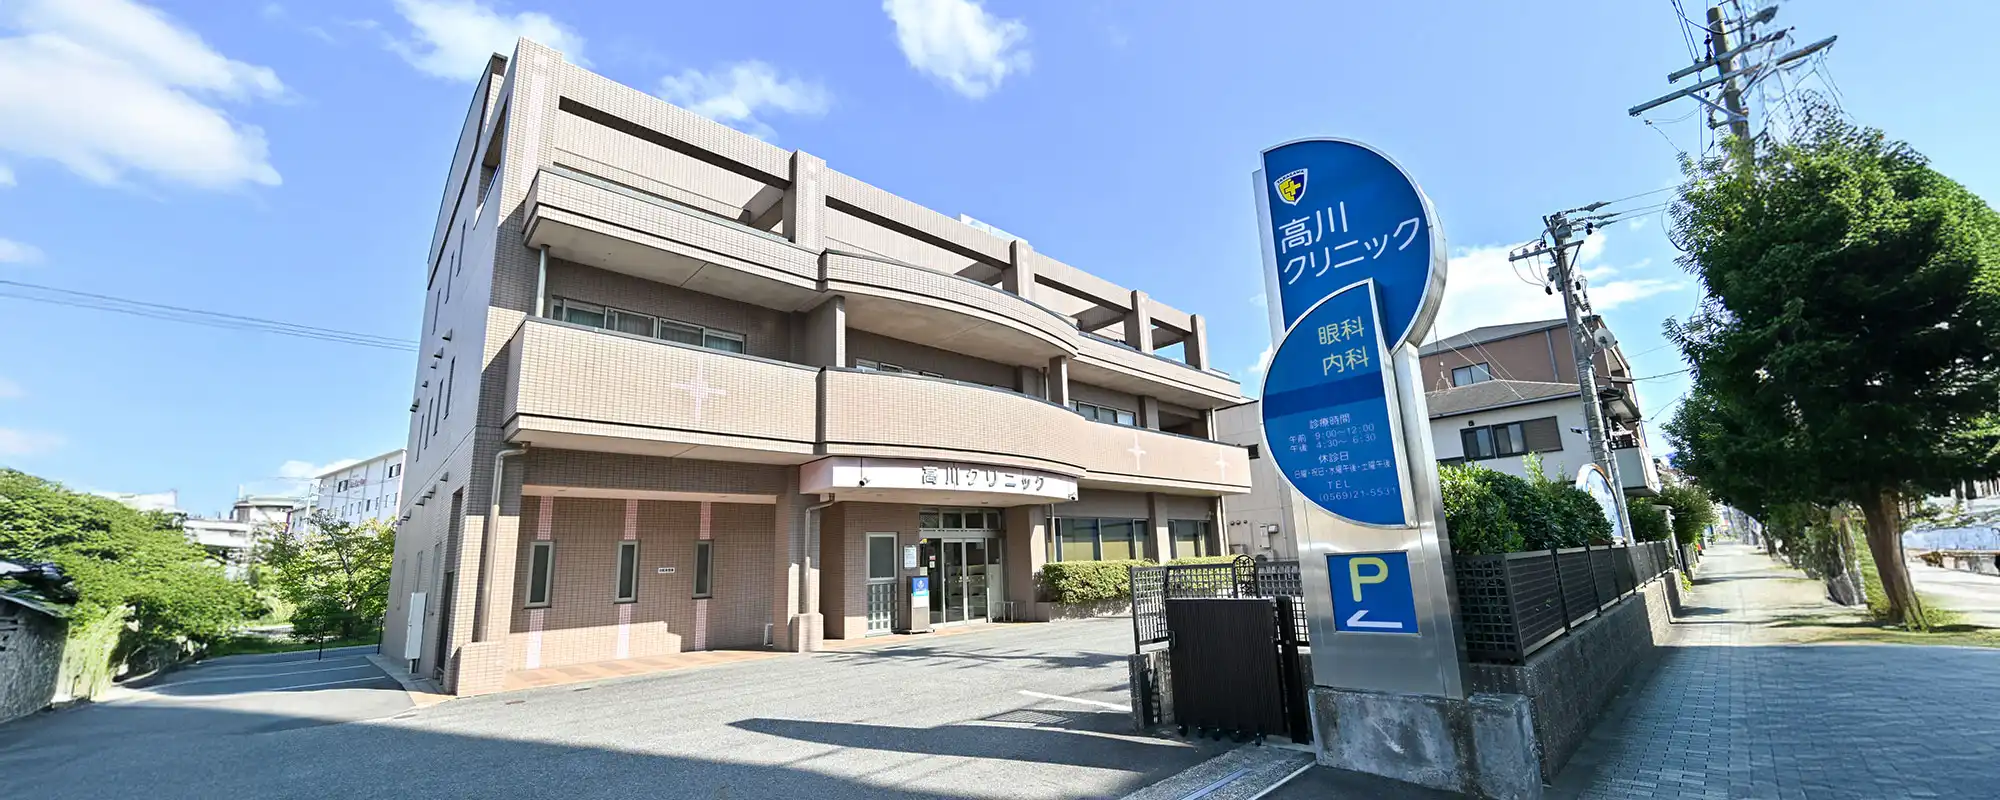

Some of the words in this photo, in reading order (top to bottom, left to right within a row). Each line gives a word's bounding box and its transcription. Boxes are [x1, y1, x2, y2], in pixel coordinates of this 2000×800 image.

[1279, 201, 1348, 254] 高川
[1284, 217, 1419, 285] クリニック
[1317, 316, 1364, 345] 眼科
[1322, 346, 1369, 376] 内科
[1309, 413, 1350, 429] 診療時間
[1319, 451, 1349, 464] 休診日
[922, 466, 1044, 491] 高川クリニック
[1328, 480, 1350, 489] TEL
[1349, 557, 1388, 602] P
